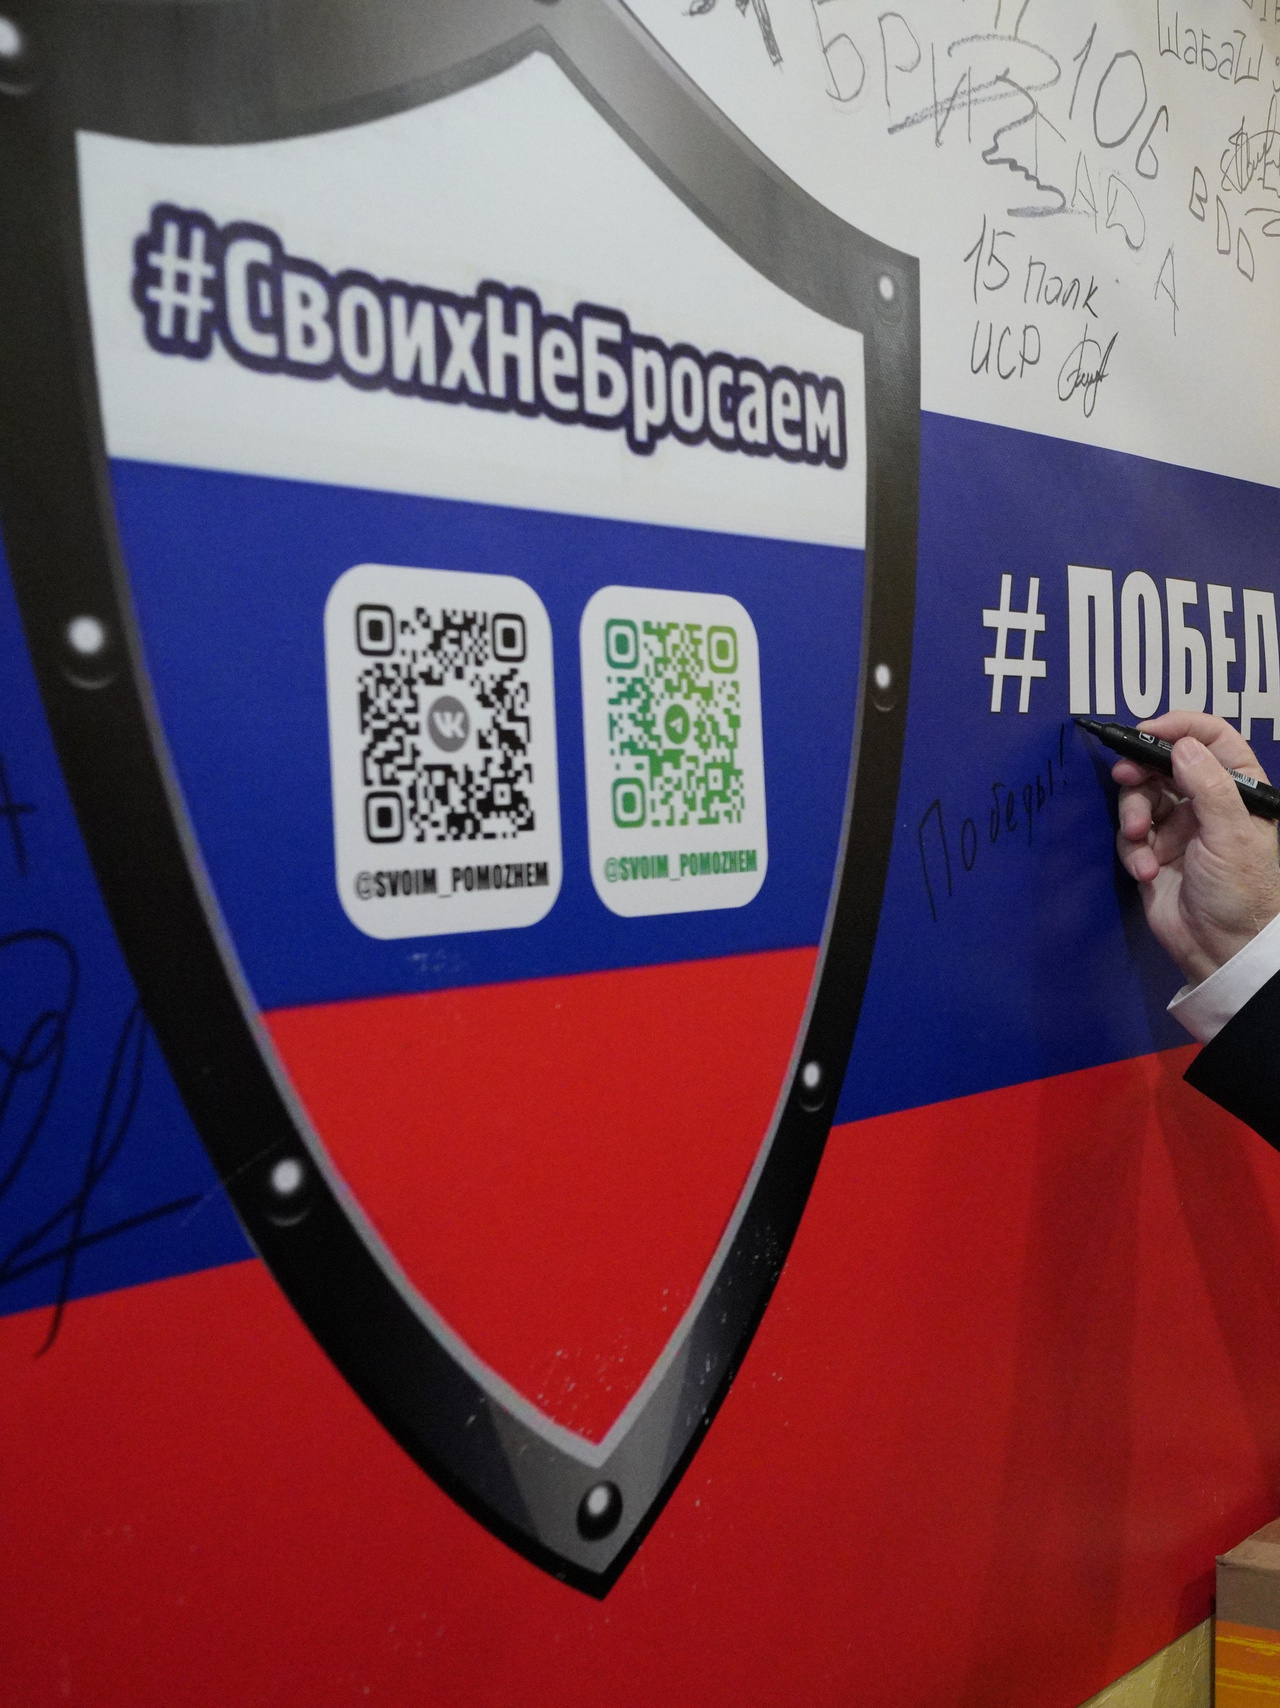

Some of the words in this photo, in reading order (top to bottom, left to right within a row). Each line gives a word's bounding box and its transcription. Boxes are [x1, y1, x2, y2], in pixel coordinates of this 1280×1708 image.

[964, 213, 1016, 304] 15
[135, 205, 845, 467] #СвоихНеБросаем
[355, 862, 549, 900] @SVOIM_POMOZHEM
